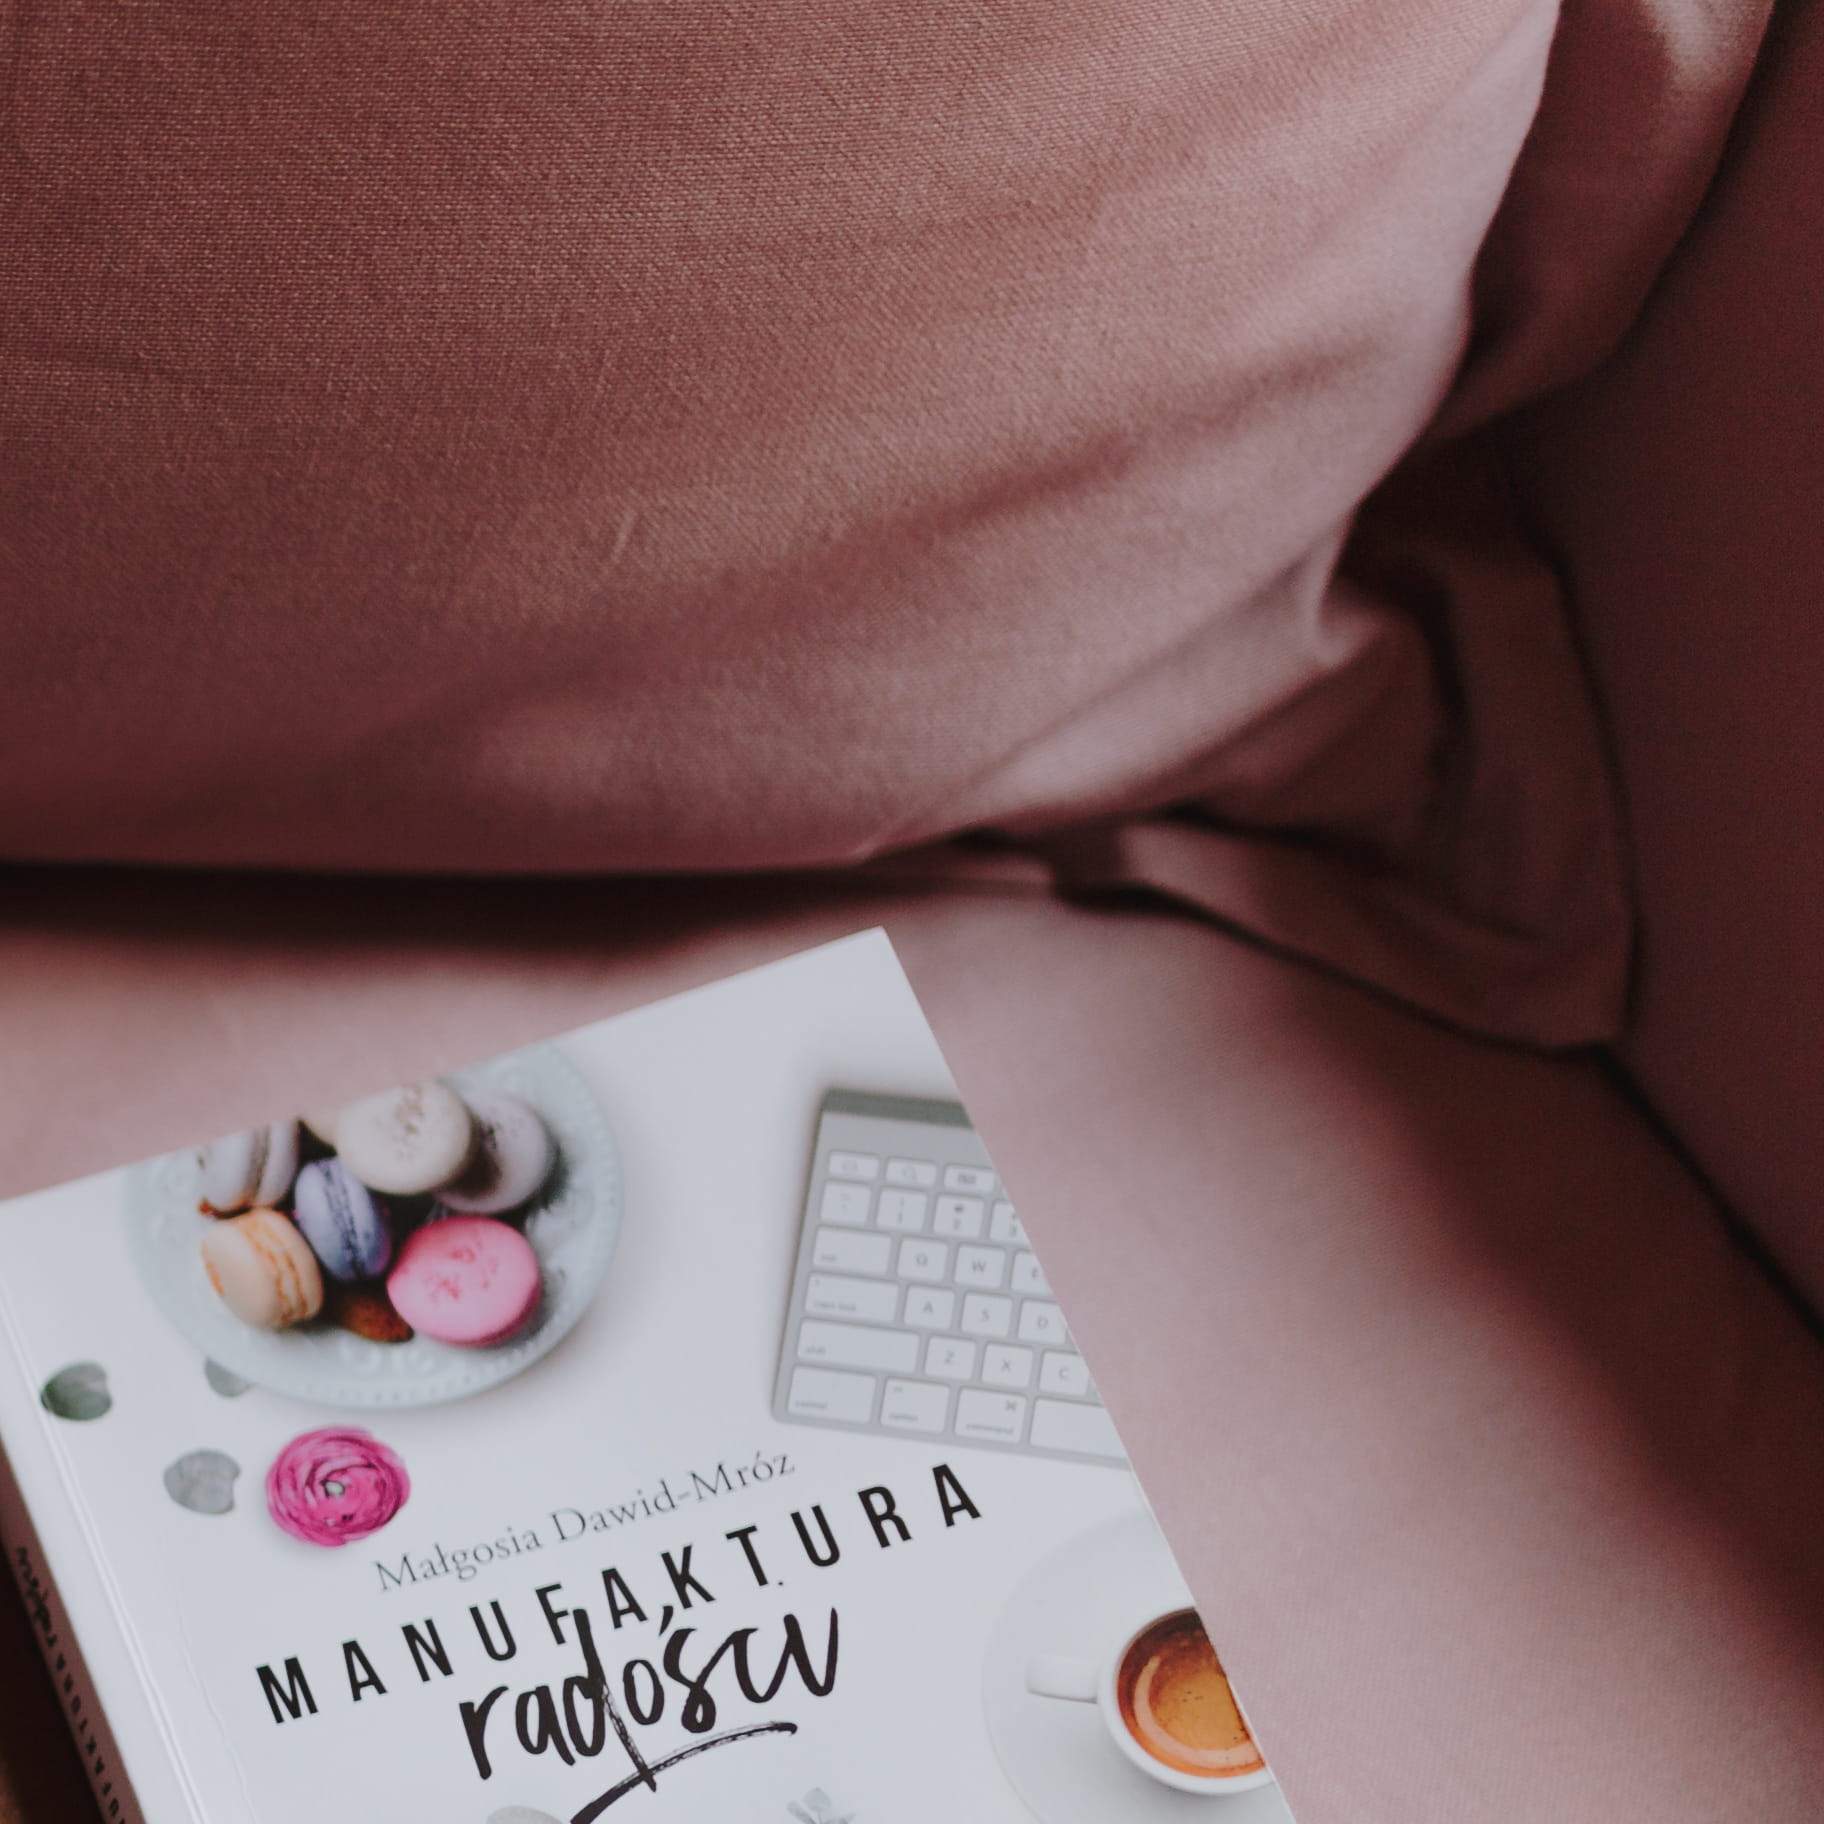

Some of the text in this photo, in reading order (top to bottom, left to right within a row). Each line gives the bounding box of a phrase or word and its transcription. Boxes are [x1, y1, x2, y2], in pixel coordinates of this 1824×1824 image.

[256, 1463, 983, 1725] MANUFAKTURA
[372, 1447, 796, 1593] Małgosia Dawid-Mróz
